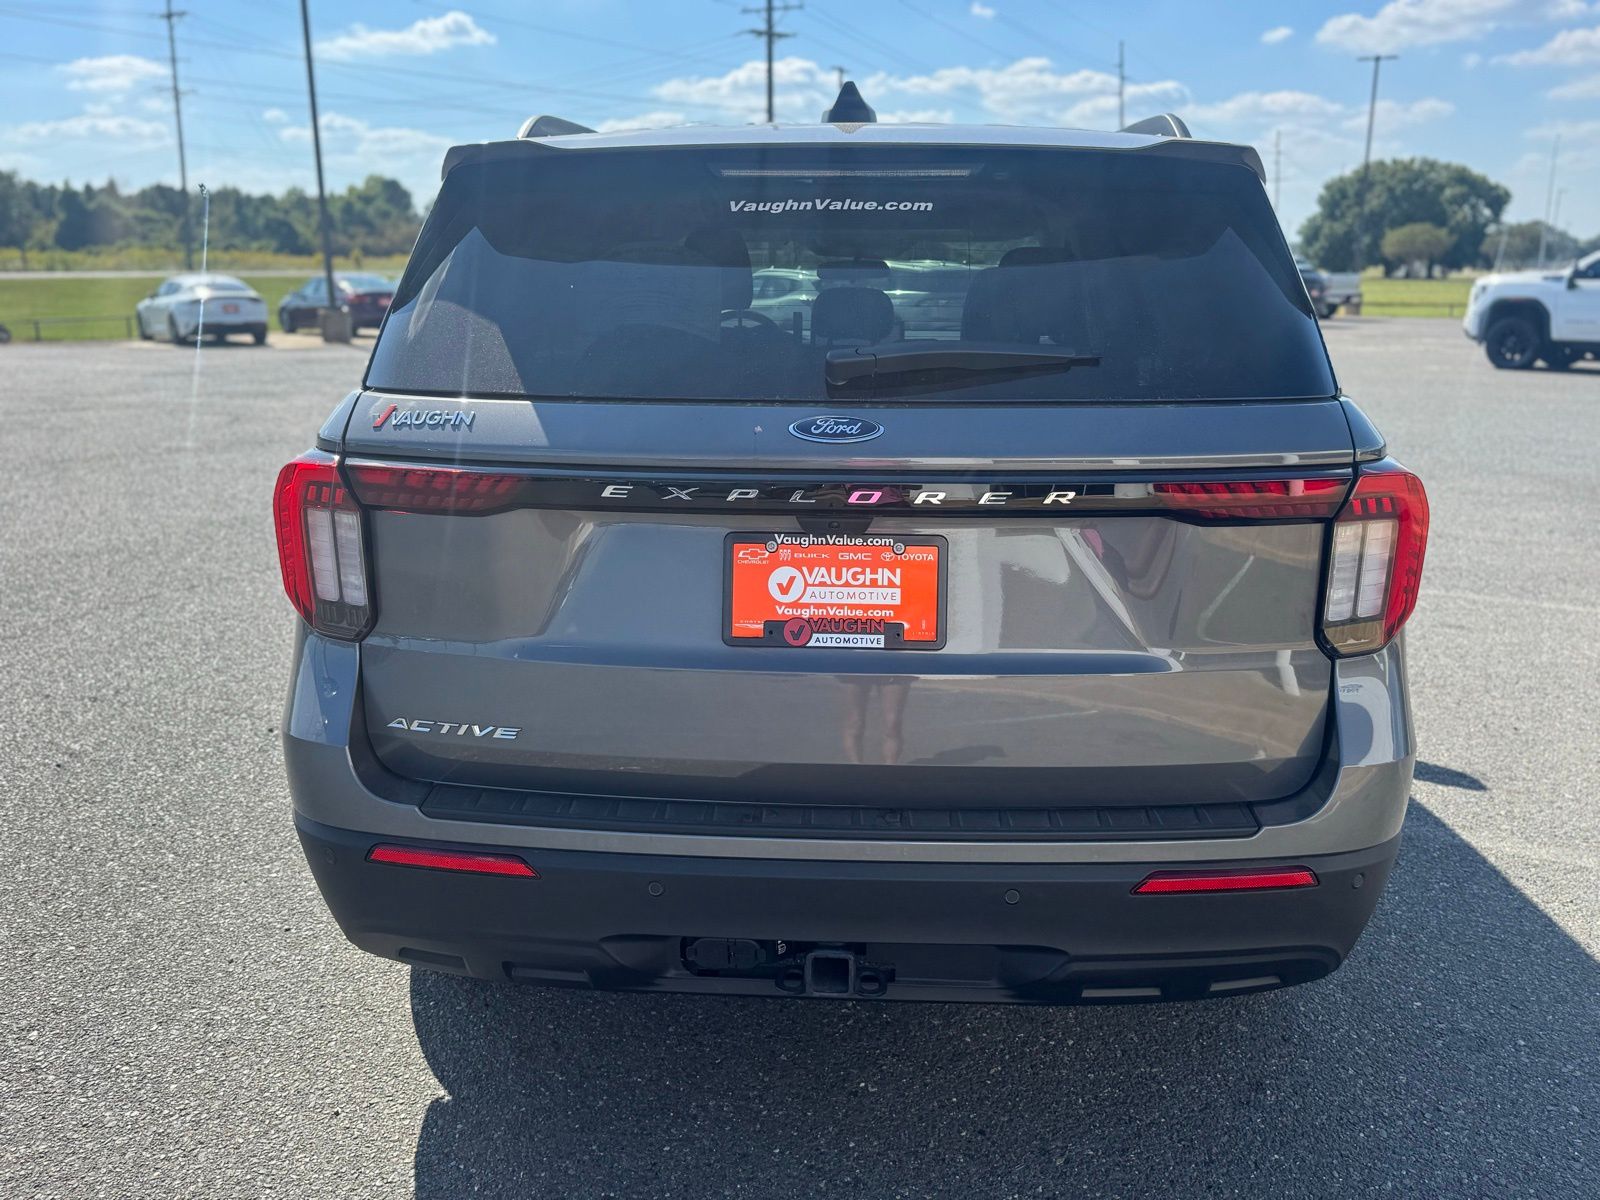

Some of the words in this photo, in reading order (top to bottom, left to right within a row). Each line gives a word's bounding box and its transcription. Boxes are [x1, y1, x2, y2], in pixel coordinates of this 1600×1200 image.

[729, 199, 933, 213] VaughnValue.com
[391, 410, 474, 427] VAUGHN
[811, 419, 862, 434] Ford
[600, 485, 1077, 505] EXPLORER
[774, 534, 894, 548] VaughnValue.com
[838, 552, 872, 561] GMC
[895, 553, 934, 561] TOYOTA
[802, 567, 900, 585] VAUGHN
[810, 592, 897, 601] AUTOMOTIVE
[775, 605, 894, 618] VaughnValue.com
[810, 619, 885, 633] VAUGHN
[814, 637, 882, 645] AUTOMOTIVE
[387, 718, 521, 739] ACTIVE
